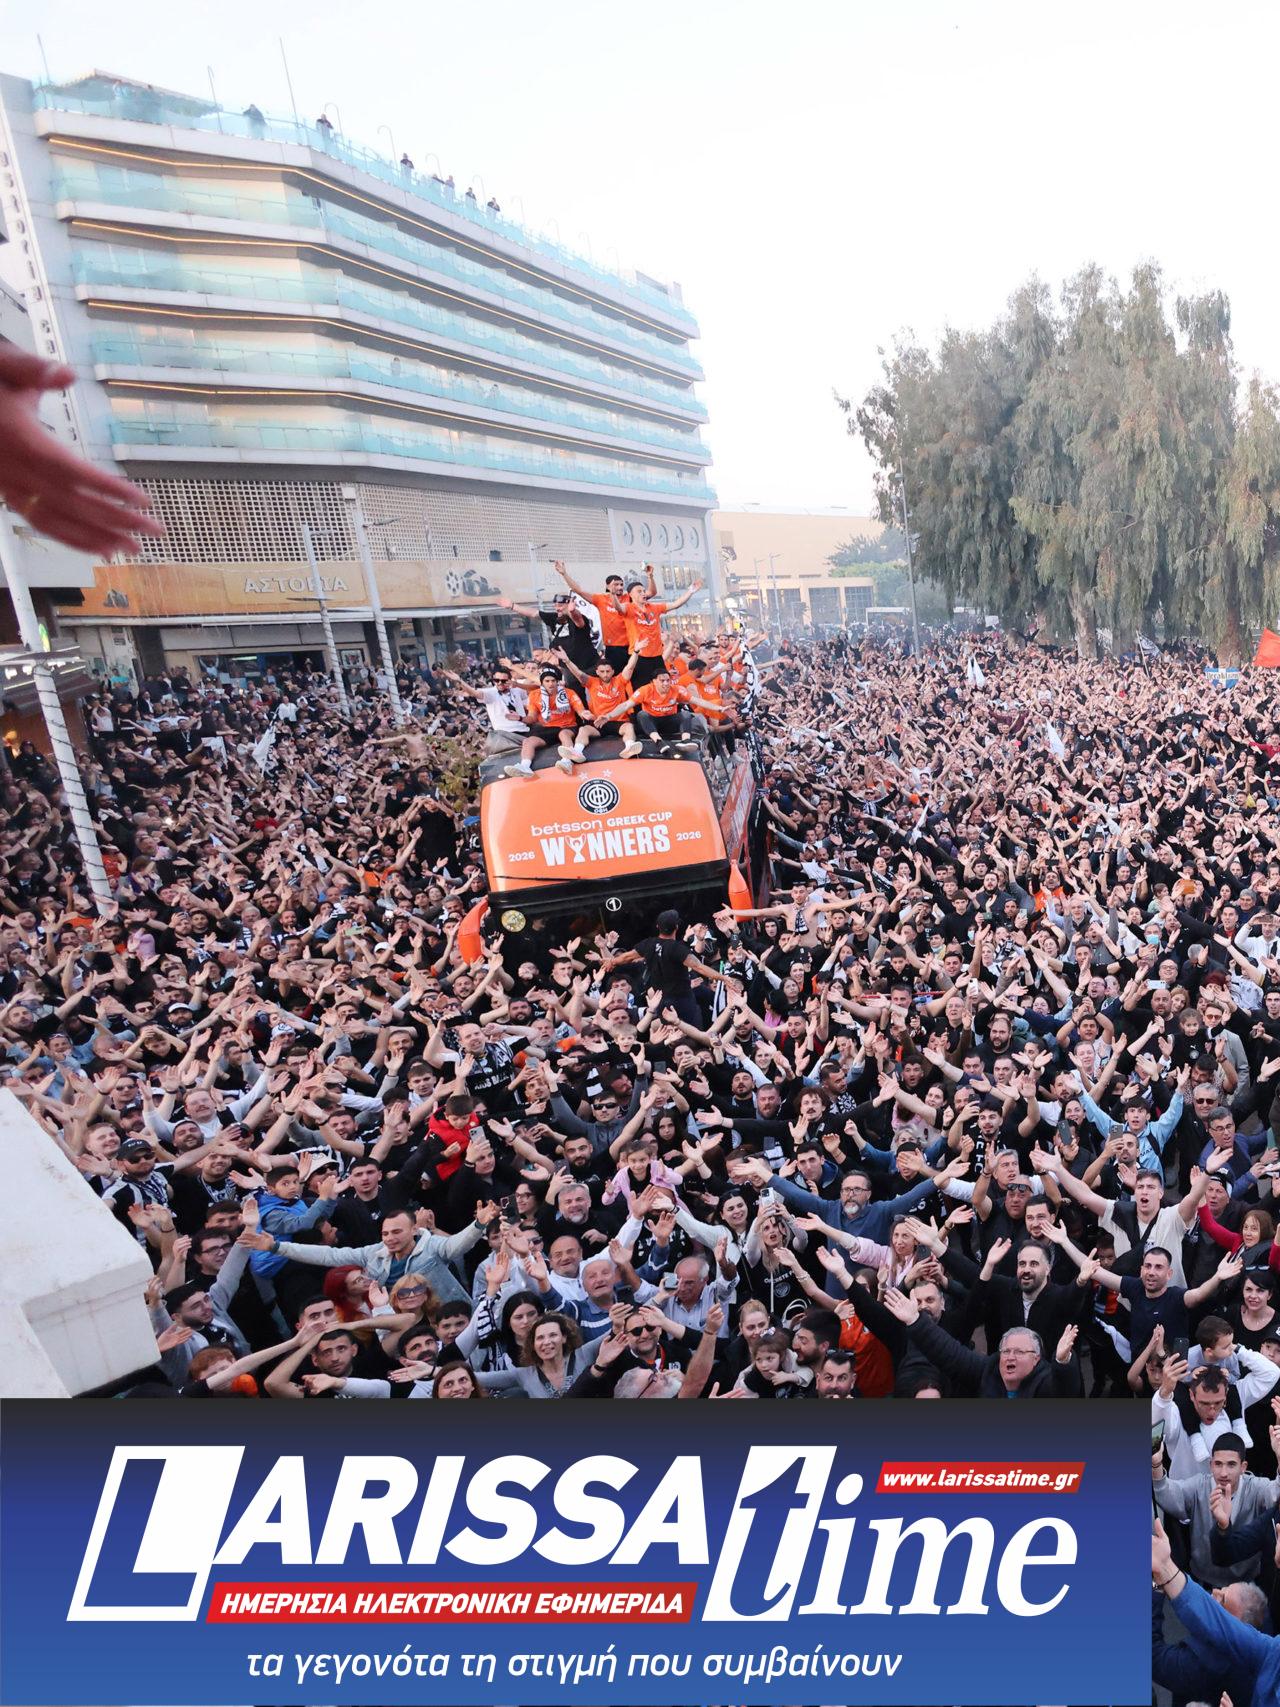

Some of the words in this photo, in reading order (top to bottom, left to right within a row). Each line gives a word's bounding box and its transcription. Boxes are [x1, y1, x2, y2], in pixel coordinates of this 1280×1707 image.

[530, 819, 603, 837] betsson
[606, 815, 646, 828] GREEK
[648, 811, 672, 823] CUP
[508, 851, 535, 863] 2026
[676, 831, 702, 842] 2026
